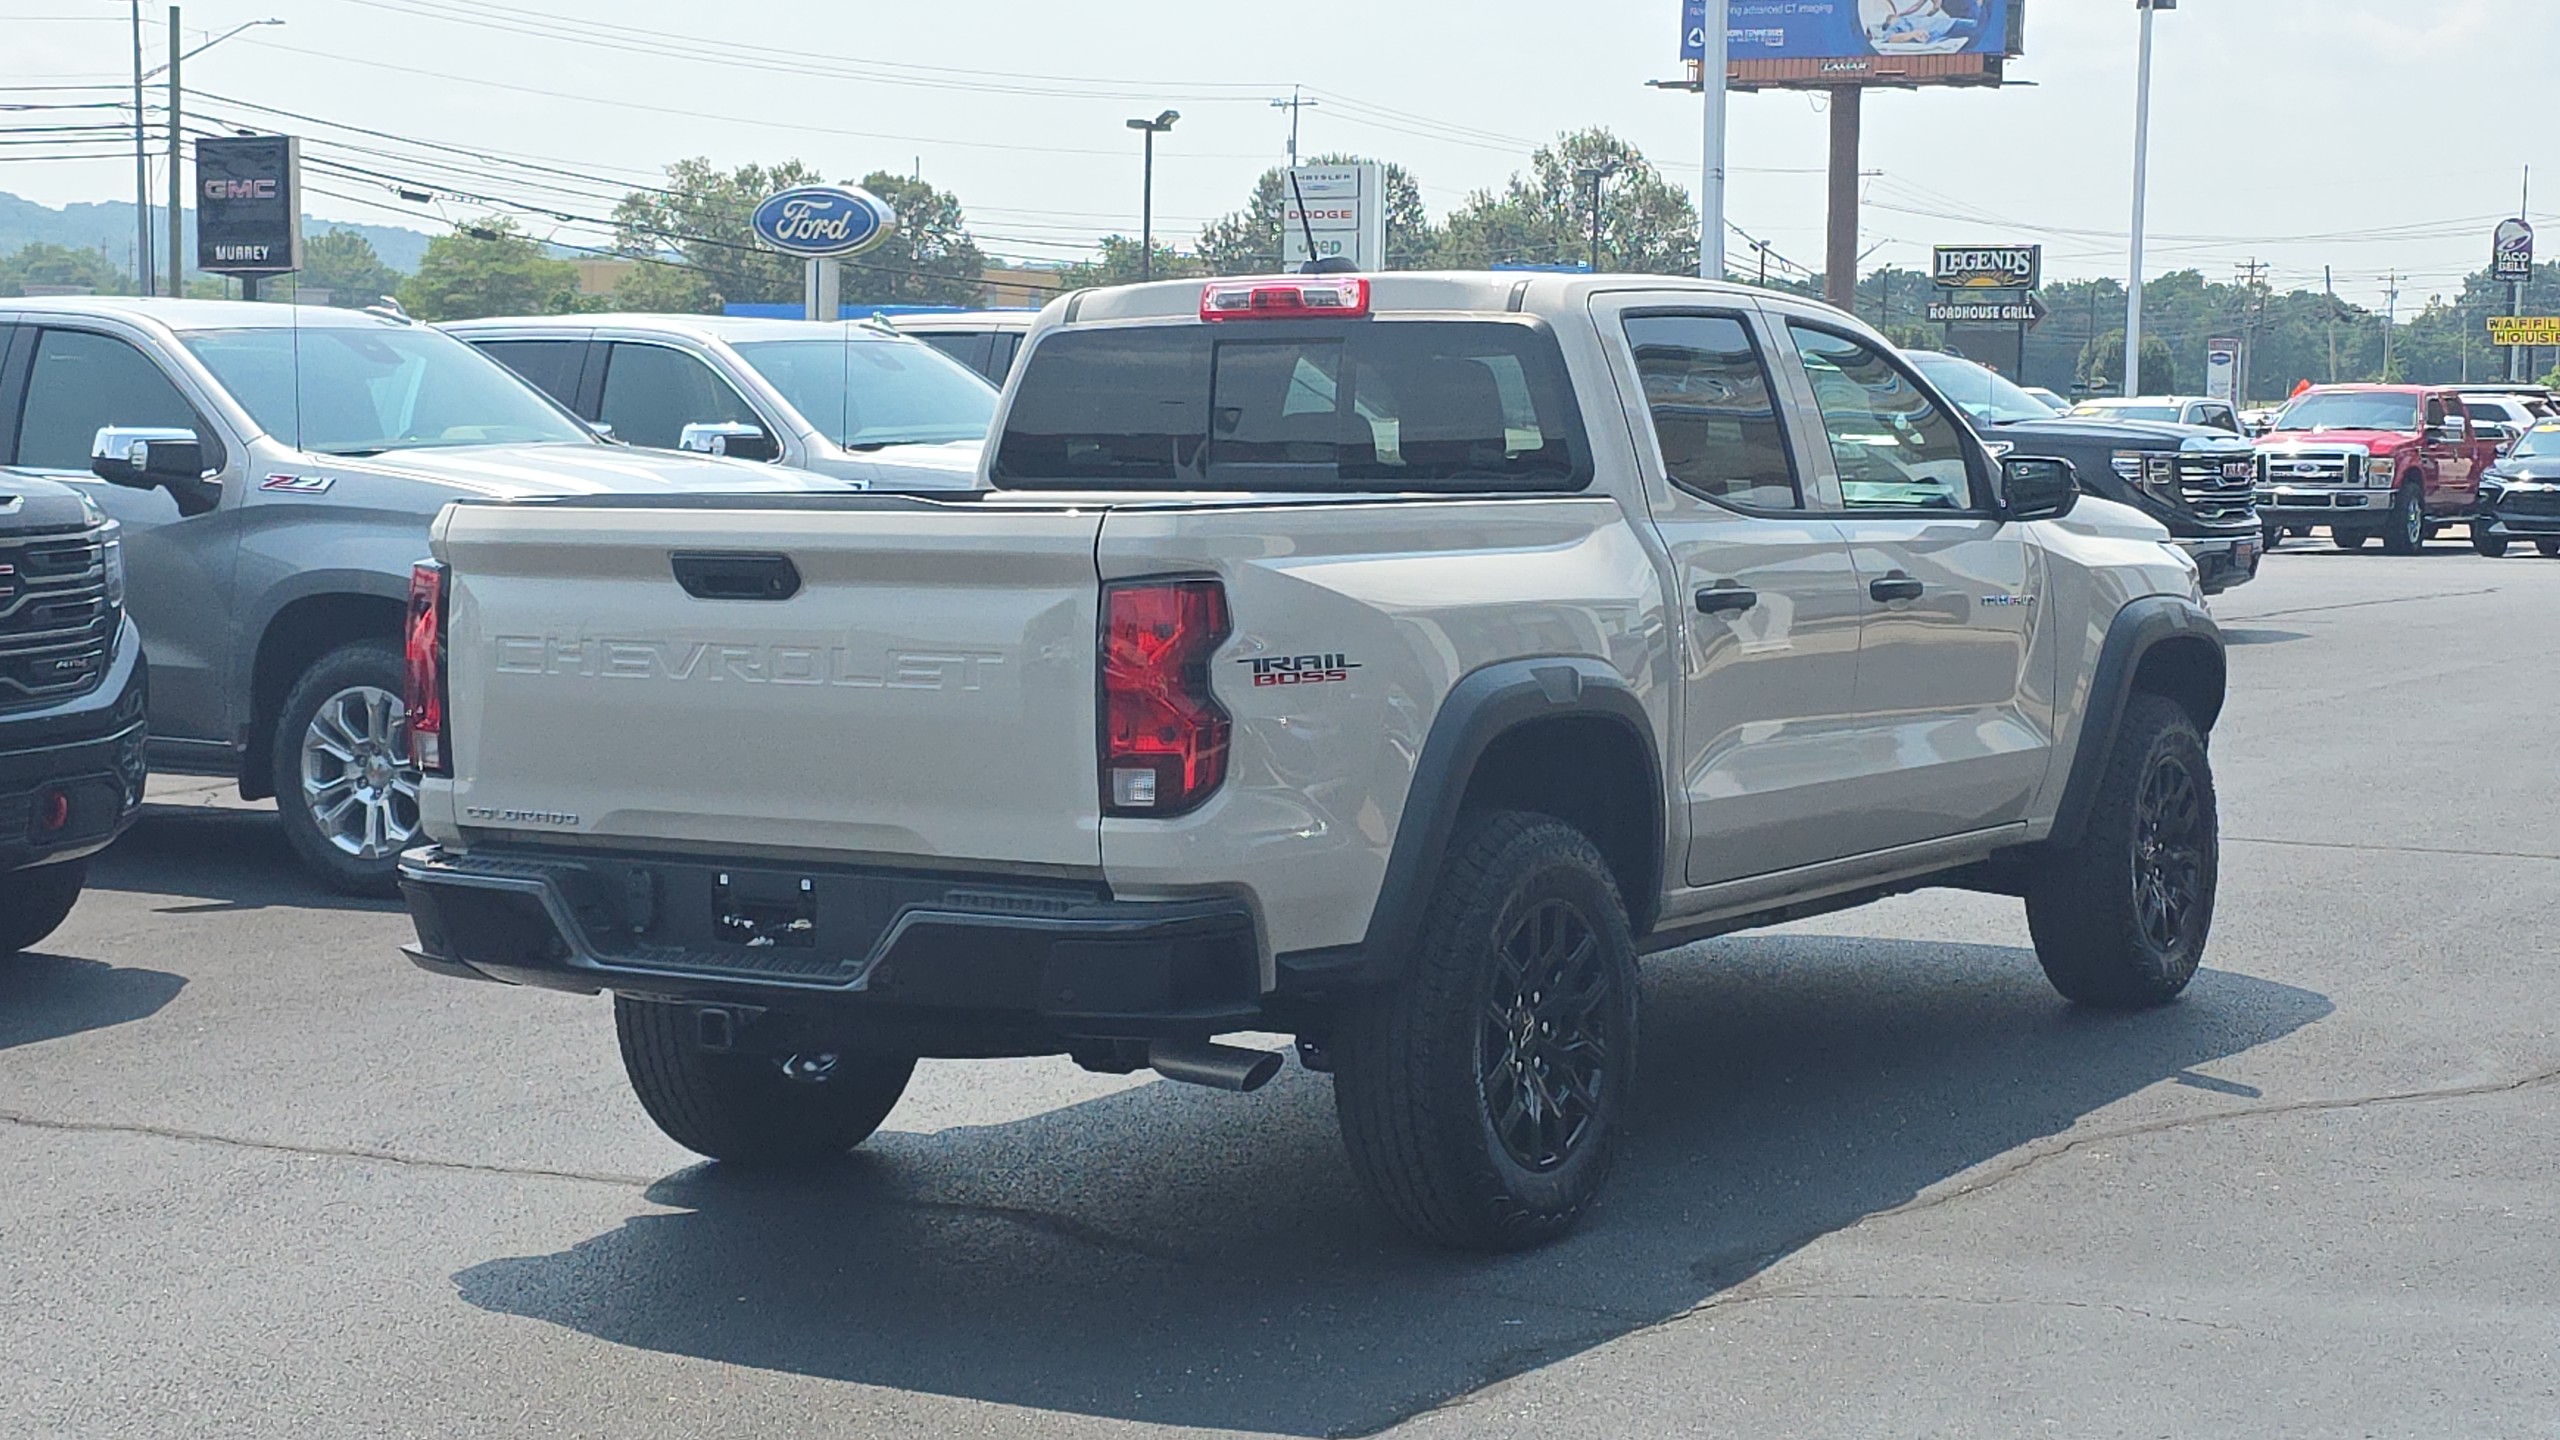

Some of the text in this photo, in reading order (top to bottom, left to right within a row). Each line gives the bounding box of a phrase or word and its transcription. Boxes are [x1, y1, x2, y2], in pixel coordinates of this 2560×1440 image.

[204, 179, 276, 199] GMC
[775, 200, 852, 240] Ford
[214, 245, 270, 260] MURREY
[2496, 251, 2530, 262] TACO
[1936, 250, 2031, 276] LEGENDS
[2498, 261, 2529, 272] BELL
[1929, 305, 2036, 319] ROADHOUSE GRILL
[2488, 319, 2560, 330] WAFFL
[258, 472, 338, 495] Z71
[495, 634, 1005, 691] CHEVROLET
[1236, 653, 1363, 673] TRAIL
[1253, 669, 1347, 687] BOSS
[466, 806, 580, 825] COLORADO
